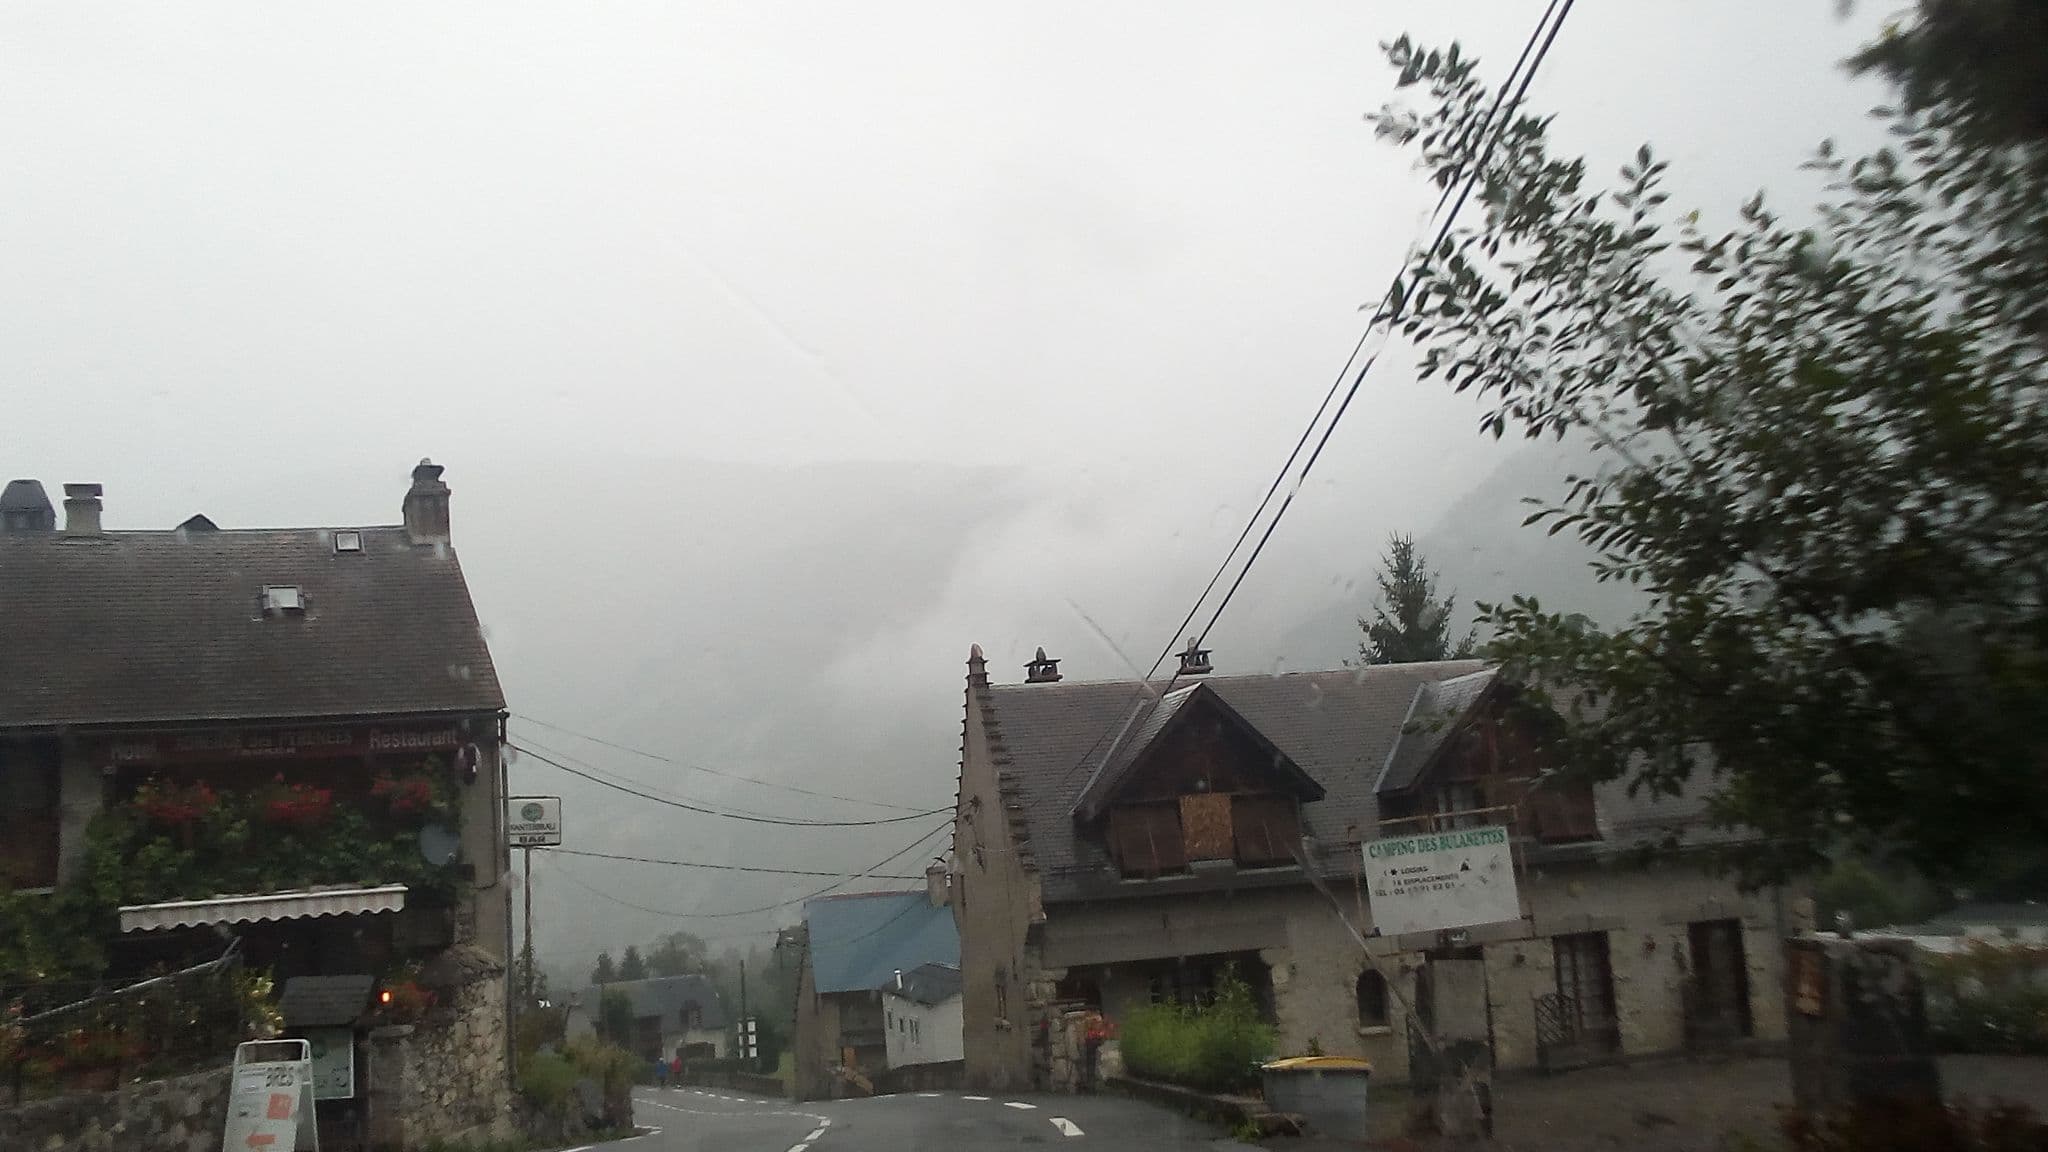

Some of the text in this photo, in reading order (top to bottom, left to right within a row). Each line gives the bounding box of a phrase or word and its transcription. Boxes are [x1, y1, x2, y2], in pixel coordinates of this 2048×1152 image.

[369, 727, 458, 750] Restaurant
[1369, 839, 1415, 858] CAMPING
[1417, 838, 1438, 853] DES
